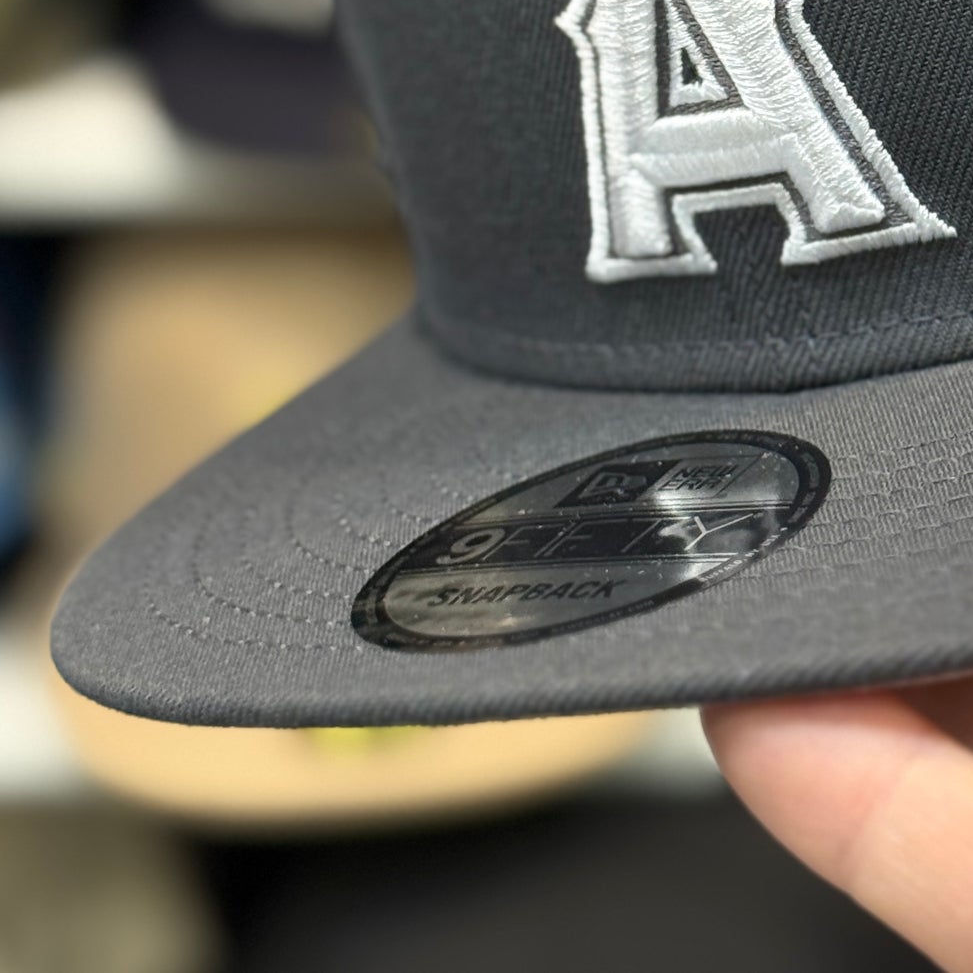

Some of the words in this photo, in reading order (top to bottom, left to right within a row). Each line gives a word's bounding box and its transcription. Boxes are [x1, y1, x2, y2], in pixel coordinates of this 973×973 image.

[672, 465, 737, 479] NEW
[659, 477, 722, 491] ERA
[436, 512, 754, 565] 9FIFTY
[428, 579, 627, 607] SNAPBACK
